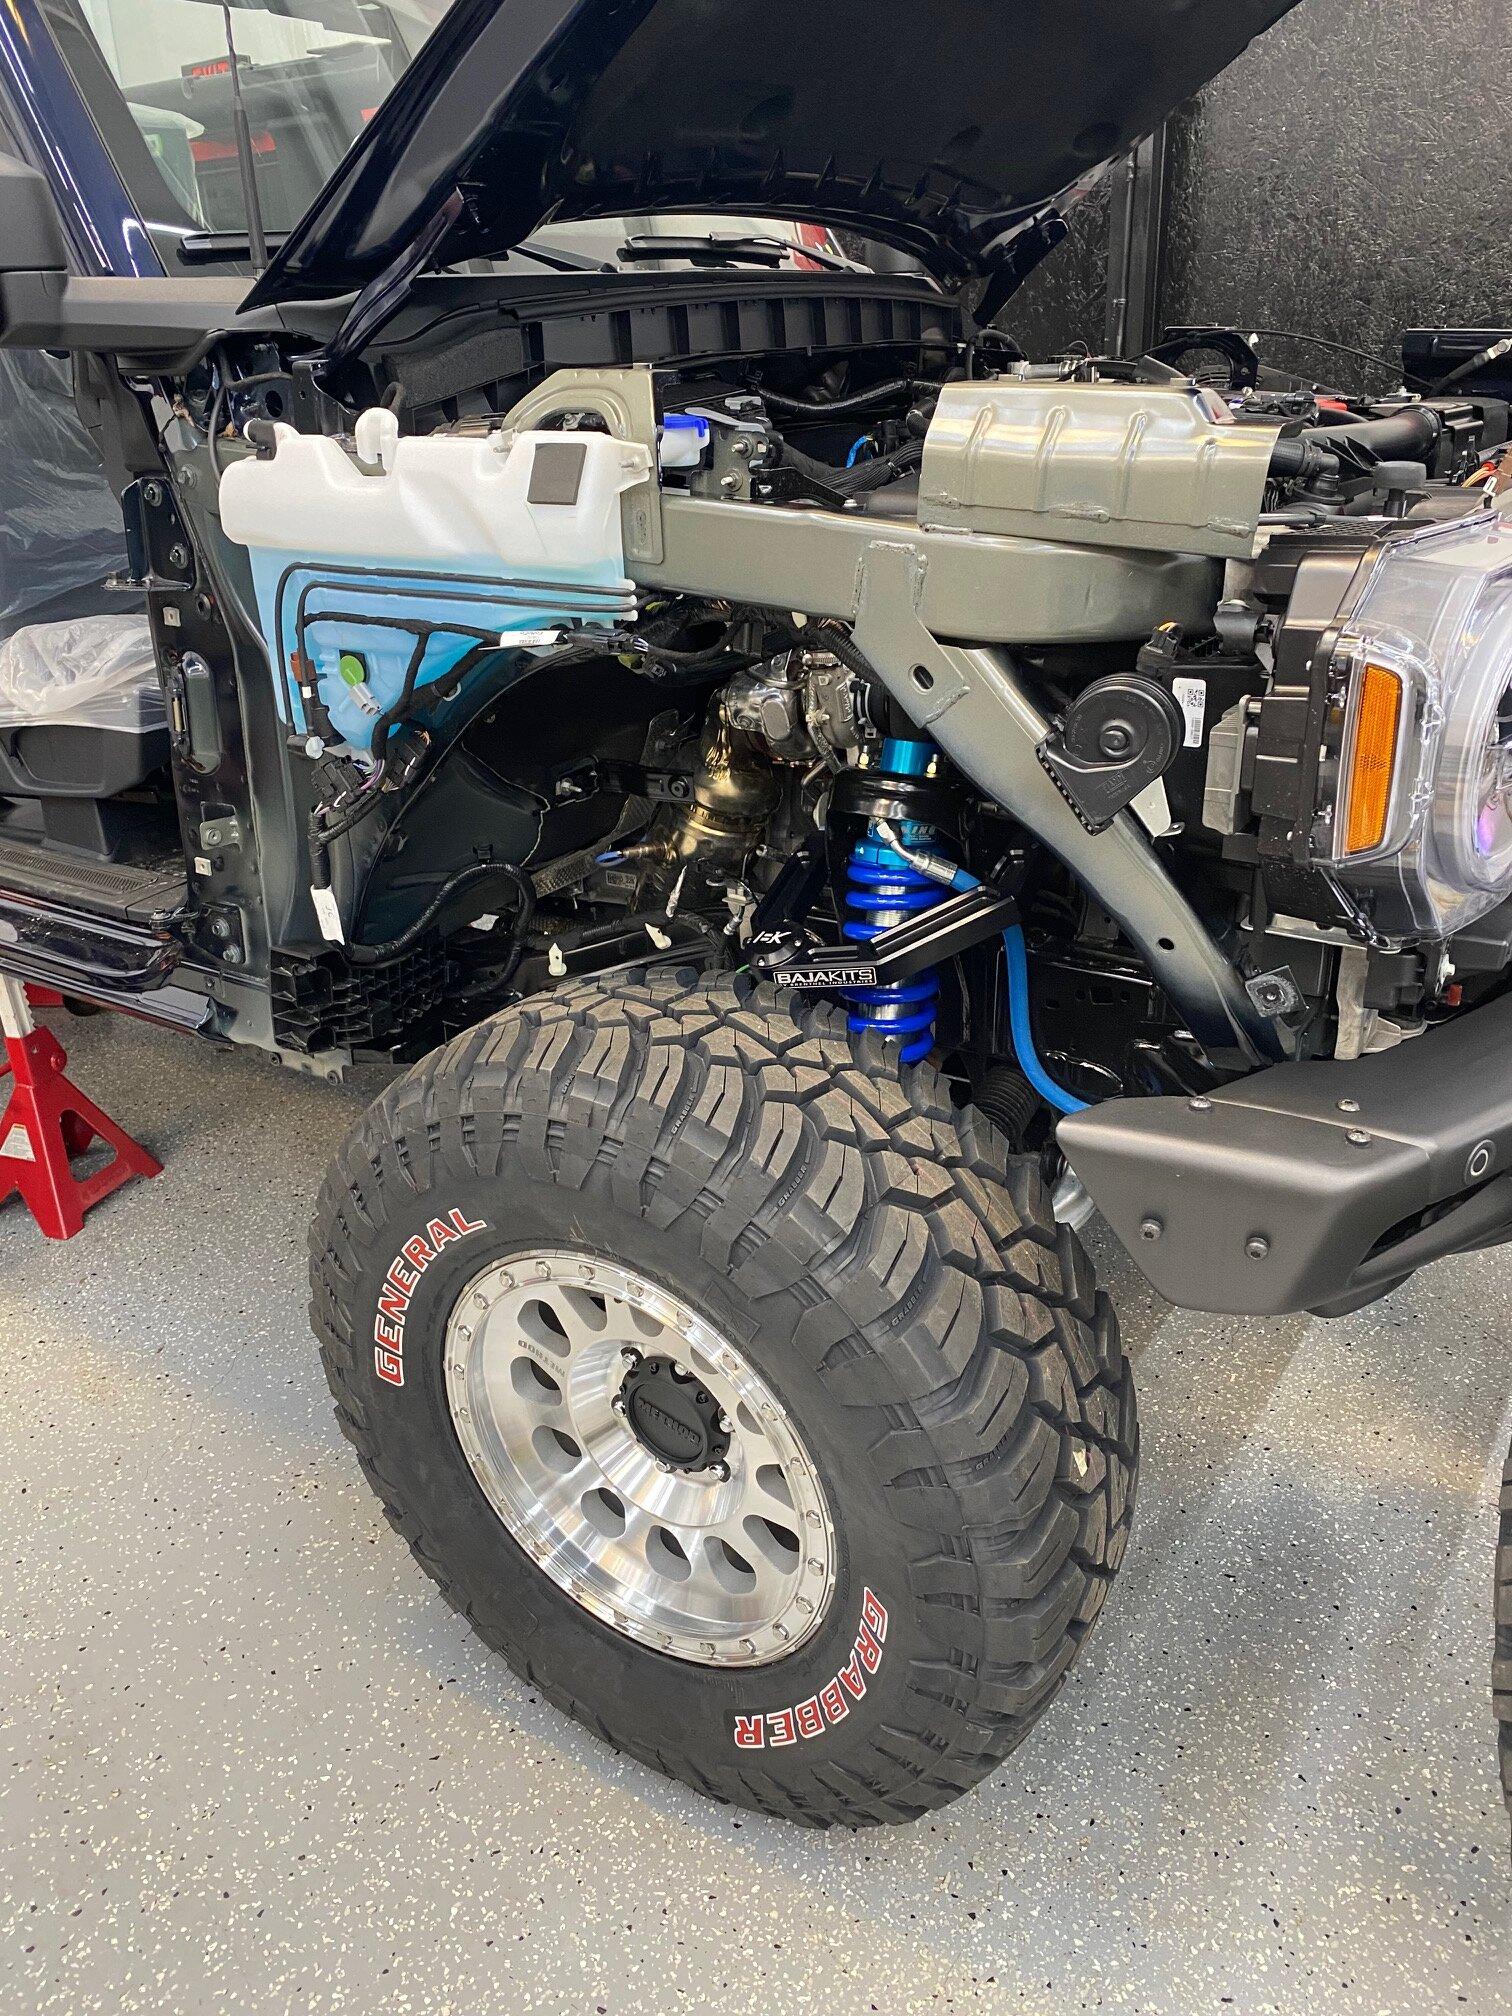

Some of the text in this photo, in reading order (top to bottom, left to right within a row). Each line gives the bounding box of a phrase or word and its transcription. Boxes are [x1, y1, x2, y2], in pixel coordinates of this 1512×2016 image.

[776, 969, 873, 984] BAJAKITS
[374, 1207, 487, 1387] GENERAL
[734, 1586, 889, 1749] GRABBER
